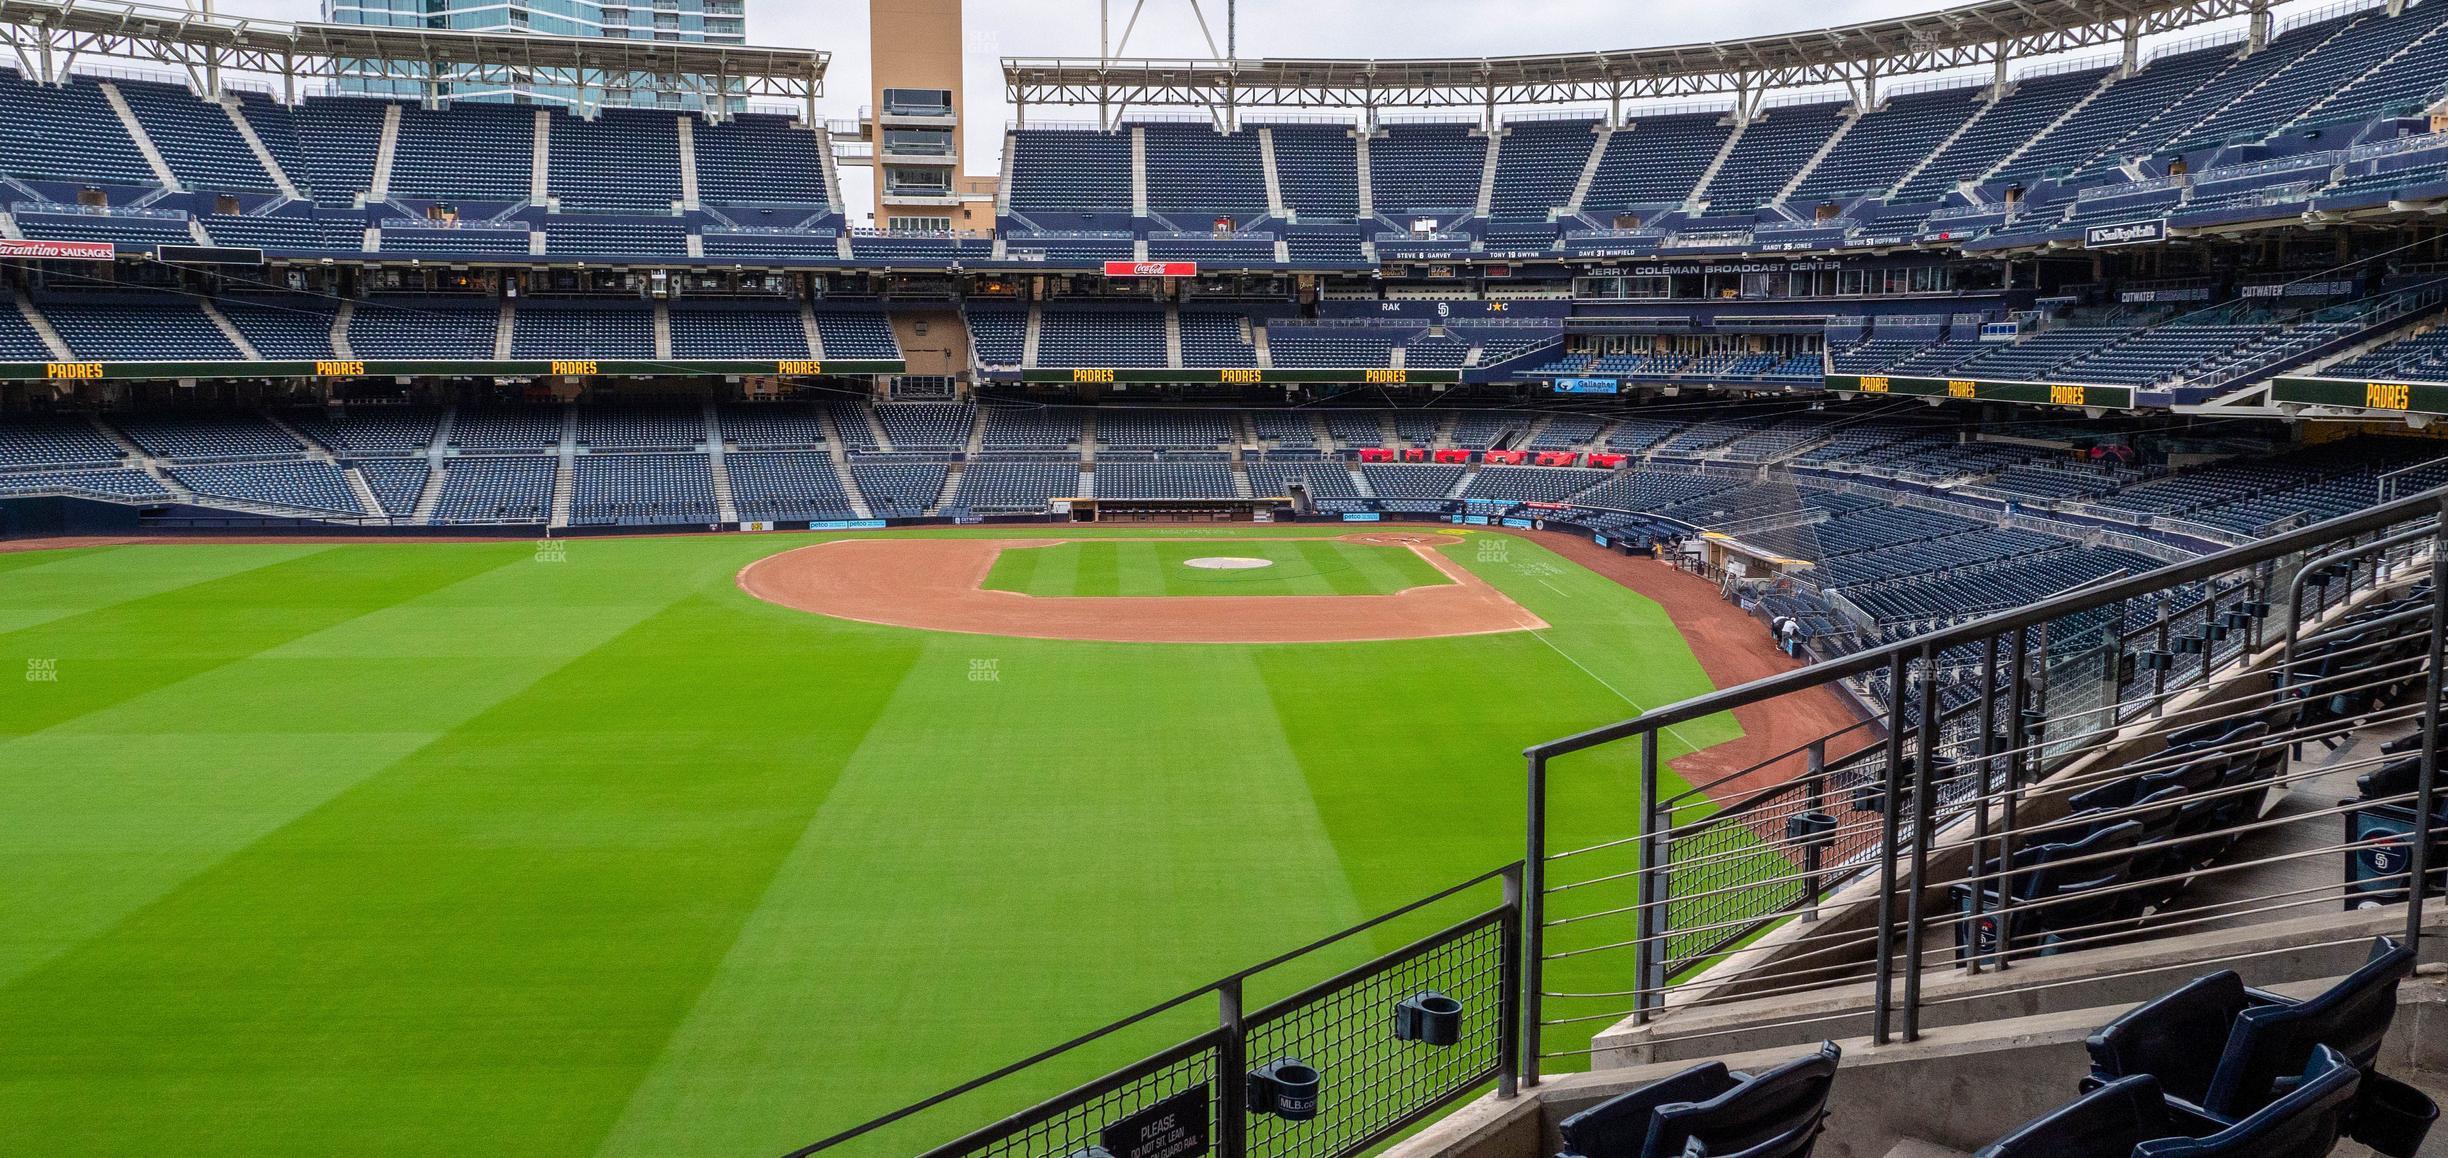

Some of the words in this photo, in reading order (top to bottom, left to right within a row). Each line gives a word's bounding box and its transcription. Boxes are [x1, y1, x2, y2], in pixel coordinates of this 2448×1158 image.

[60, 248, 112, 259] SAUSAGES
[1508, 251, 1516, 259] 19
[1606, 249, 1635, 257] WINFIELD
[1588, 267, 1630, 275] JERRY
[1635, 265, 1700, 274] COLEMAN
[1705, 263, 1786, 273] BROADCAST
[1790, 261, 1841, 270] CENTER
[2122, 291, 2155, 302] CUTWATER
[2242, 285, 2283, 297] CUTWATER
[1382, 303, 1400, 311] RAK
[47, 364, 104, 379] PADRES
[317, 361, 365, 376] PADRES
[551, 361, 598, 375] PADRES
[778, 360, 821, 374] PADRES
[1073, 369, 1115, 382] PADRES
[1221, 369, 1262, 382] PADRES
[1366, 369, 1407, 382] PADRES
[1577, 380, 1615, 389] Gallagher
[1860, 377, 1889, 392] PADRES
[1948, 380, 1976, 398] PADRES
[2050, 385, 2084, 405] PADRES
[2366, 383, 2410, 410] PADRES
[849, 519, 867, 528] petco
[1344, 513, 1361, 521] petco
[810, 521, 829, 530] petco
[1141, 1113, 1175, 1142] PLEASE
[1131, 1147, 1141, 1158] DO
[1142, 1140, 1155, 1156] NOT
[1156, 1135, 1167, 1149] SIT,
[1168, 1126, 1184, 1143] LEAN
[1161, 1141, 1183, 1158] GUARD
[1184, 1135, 1198, 1149] RAIL
